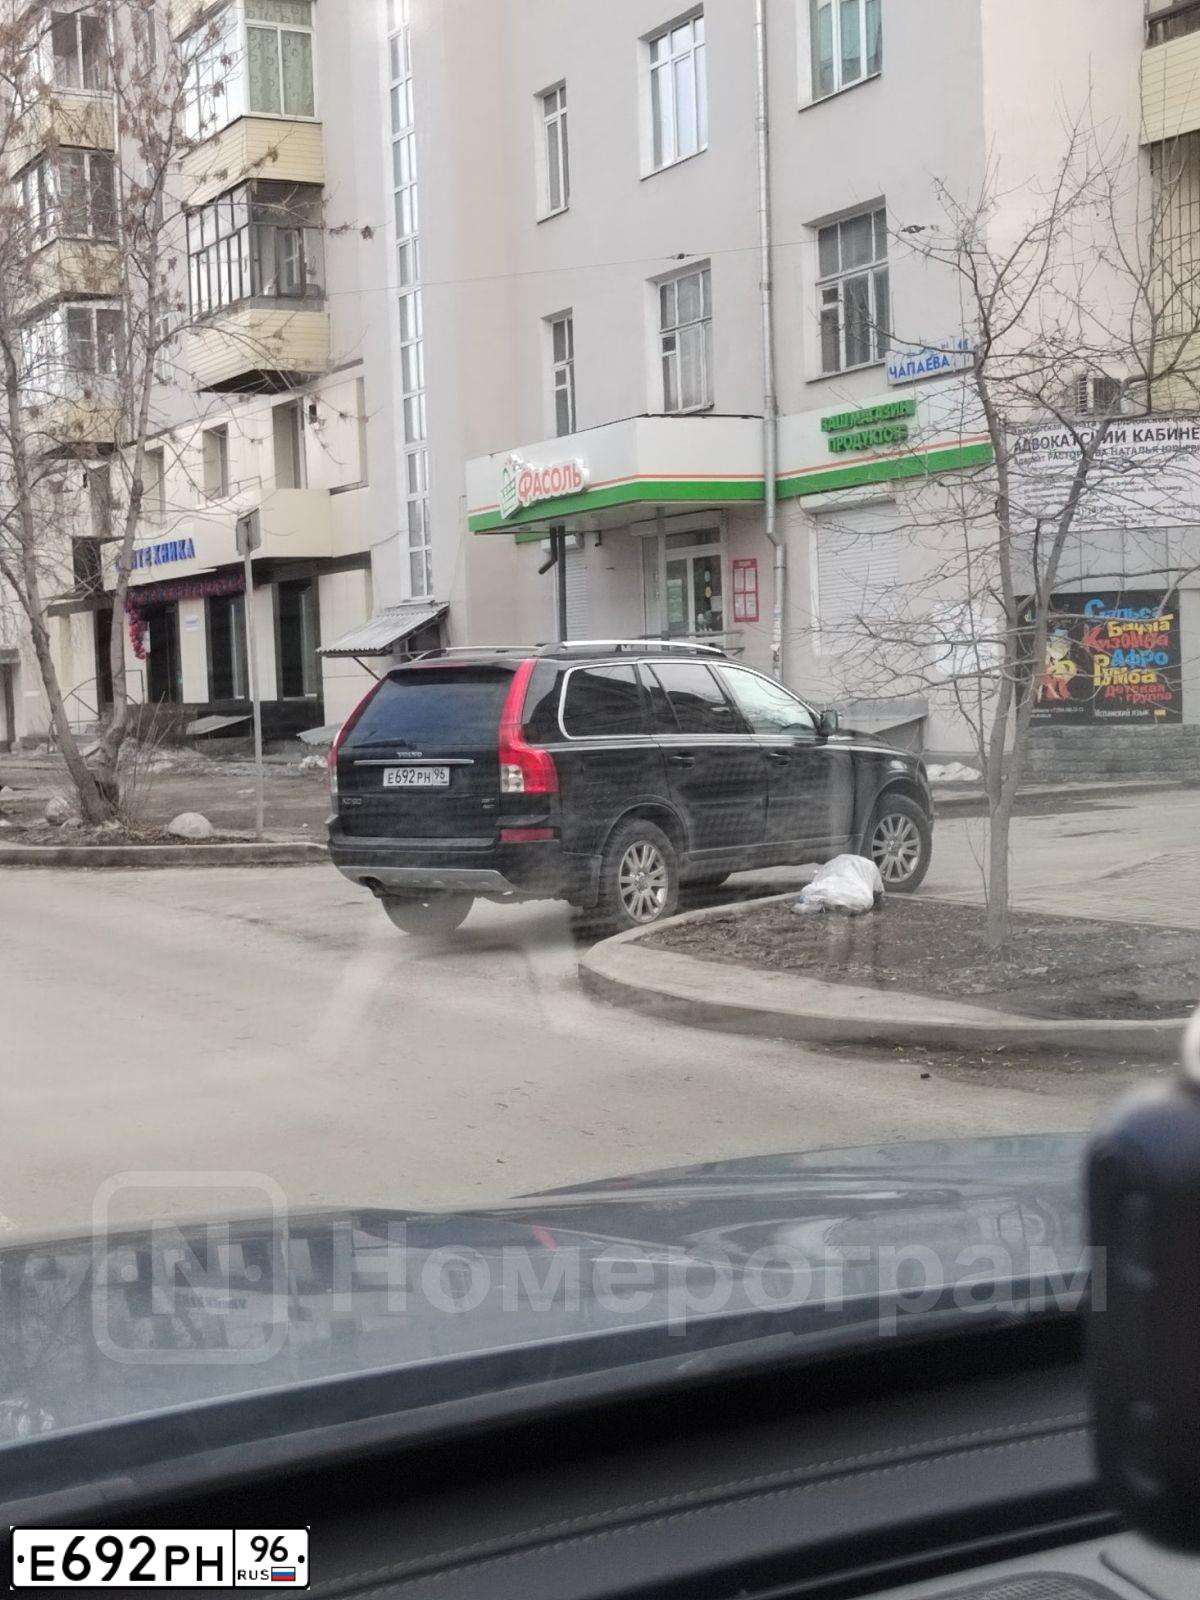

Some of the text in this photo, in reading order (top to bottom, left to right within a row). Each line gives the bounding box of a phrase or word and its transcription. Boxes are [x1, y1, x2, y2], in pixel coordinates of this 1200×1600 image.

[889, 353, 950, 379] ЧАПАЕВА
[828, 424, 908, 452] ПРОДУКТОВ
[519, 463, 582, 501] ФАСОЛЬ
[387, 769, 446, 783] Е692РН 96
